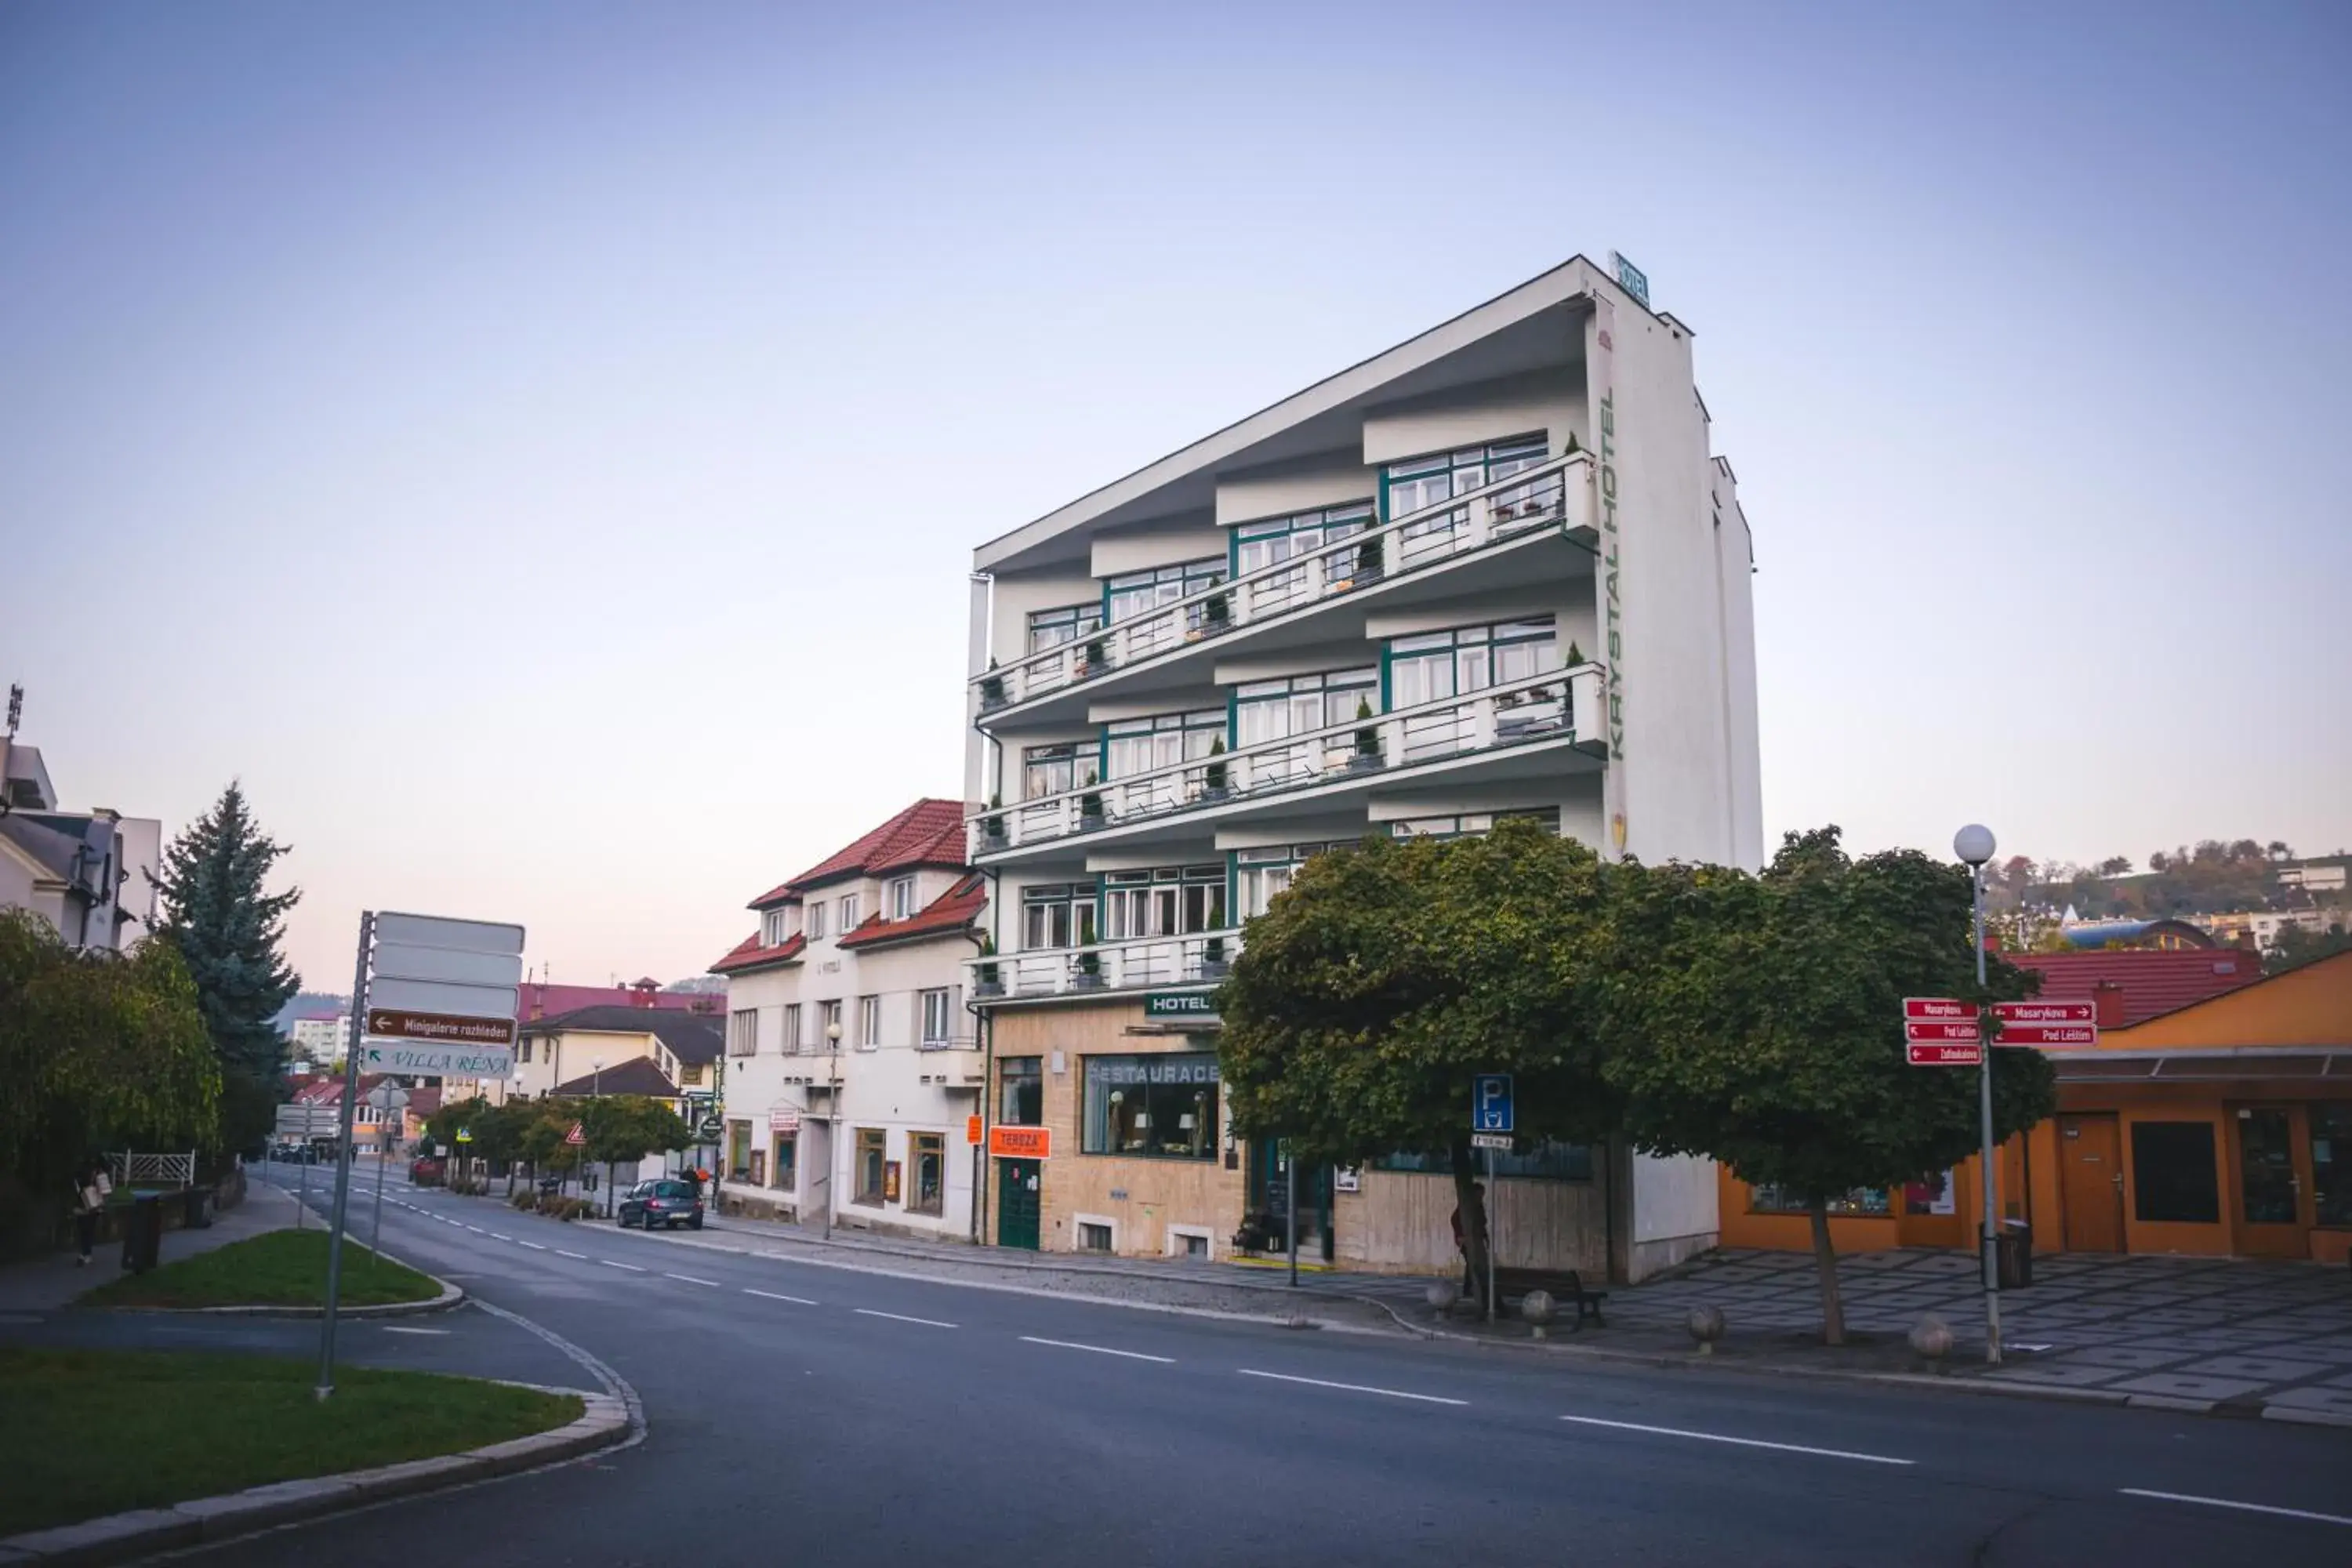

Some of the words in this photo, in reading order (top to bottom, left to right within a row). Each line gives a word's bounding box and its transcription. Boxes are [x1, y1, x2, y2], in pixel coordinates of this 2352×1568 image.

[1600, 387, 1618, 534] HOTEL
[1605, 543, 1624, 761] KRYSTAL
[1152, 996, 1210, 1011] HOTEL
[2014, 1007, 2067, 1021] Masarykova
[404, 1017, 459, 1036] Minigalerie
[460, 1022, 508, 1038] rozhleden
[2042, 1029, 2060, 1041] Pod
[393, 1051, 451, 1071] VILLA
[1088, 1065, 1220, 1083] RESTAURACE
[1482, 1079, 1503, 1110] P
